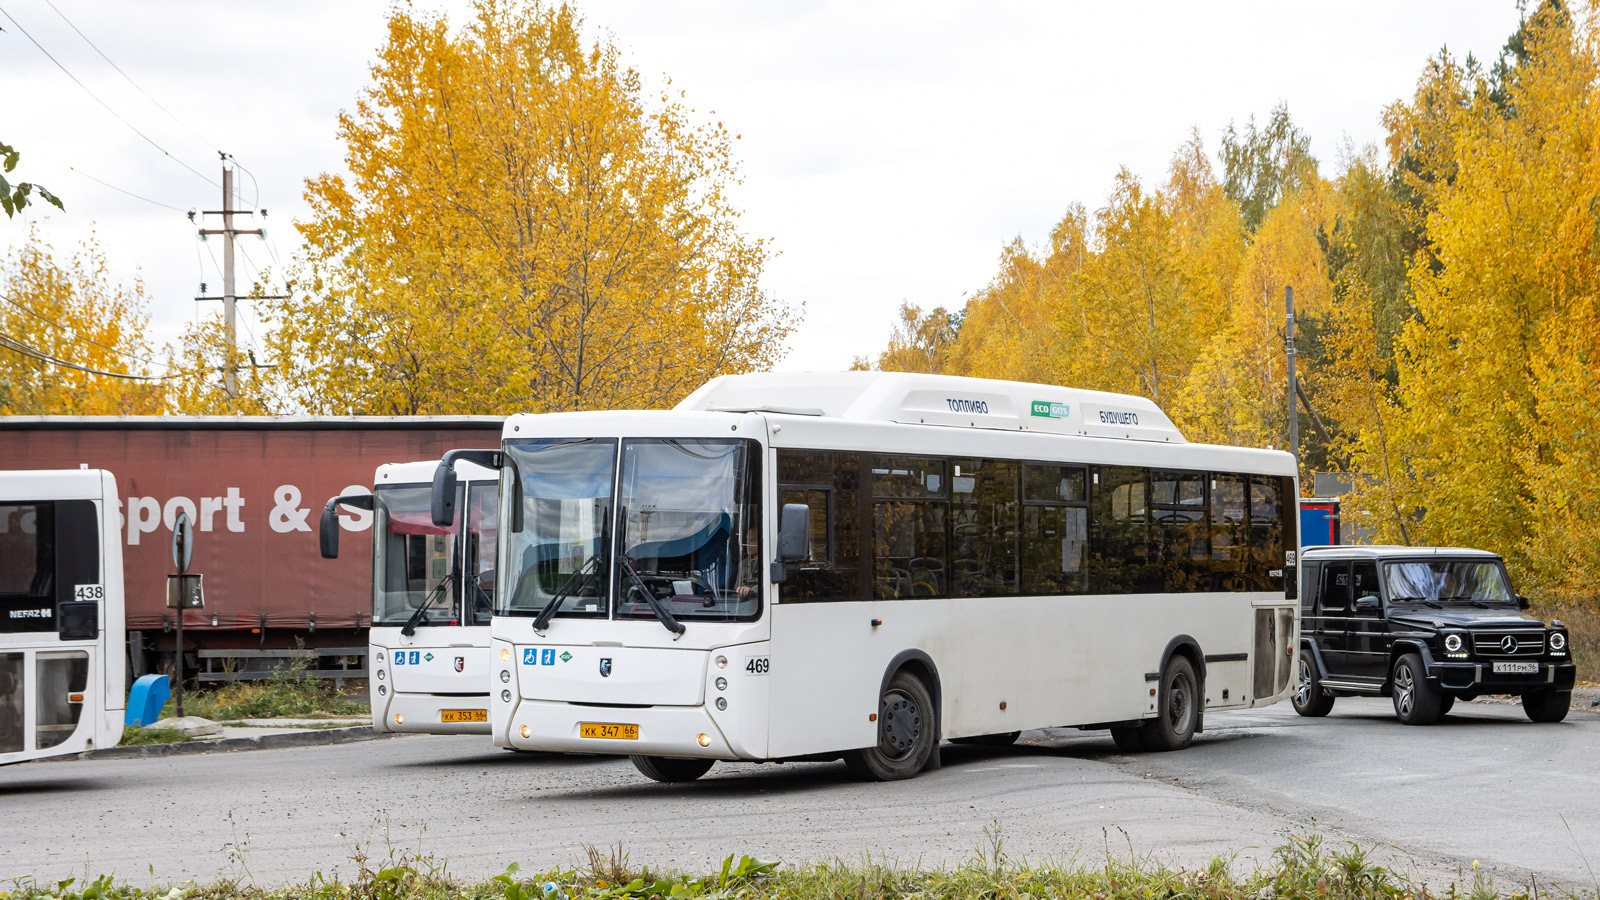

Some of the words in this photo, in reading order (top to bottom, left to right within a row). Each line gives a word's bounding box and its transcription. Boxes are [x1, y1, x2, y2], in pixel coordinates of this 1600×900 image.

[947, 399, 989, 414] ТОПЛИВО
[1034, 404, 1049, 414] ECO
[1099, 410, 1139, 426] БУДУЩЕГО
[269, 484, 312, 533] &
[76, 586, 103, 599] 438
[9, 610, 41, 618] NEFAZ
[745, 658, 769, 673] 469
[444, 713, 455, 721] КК
[457, 711, 472, 721] 353
[585, 728, 597, 736] КК
[600, 725, 619, 737] 347
[624, 726, 635, 735] 66
